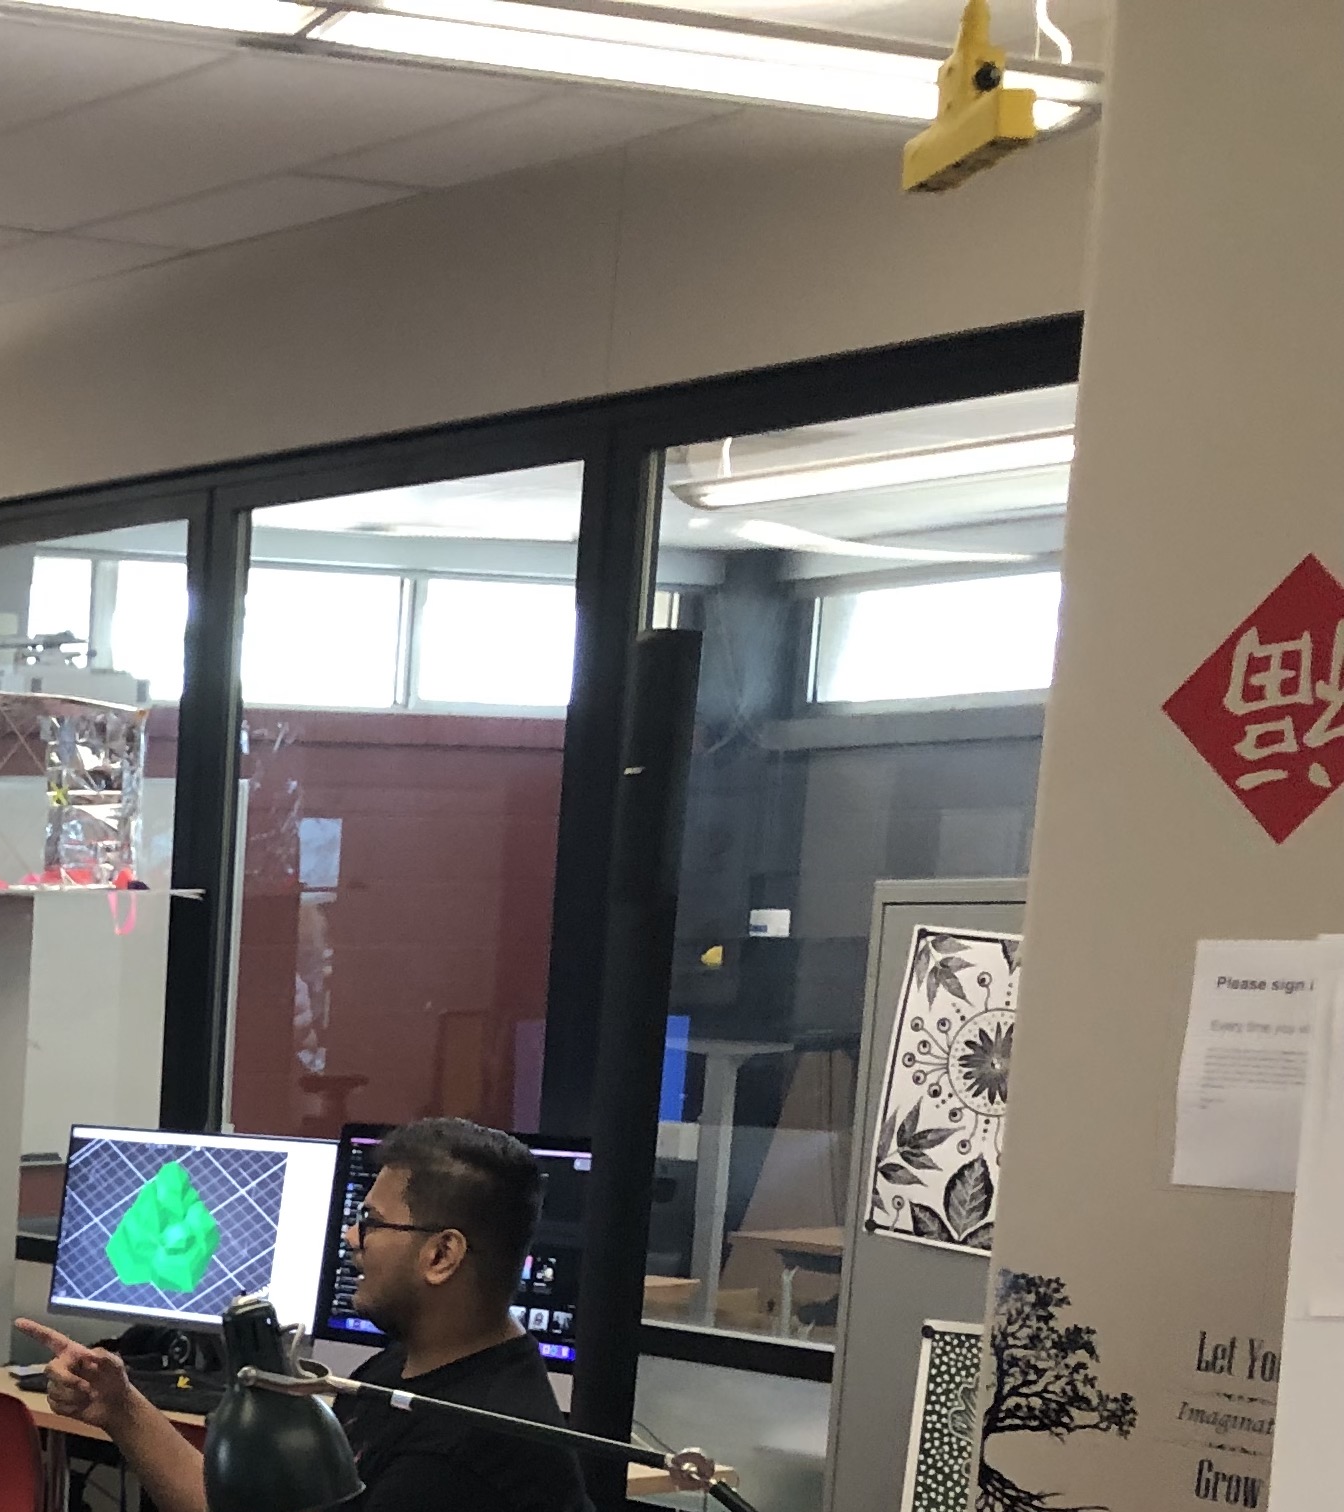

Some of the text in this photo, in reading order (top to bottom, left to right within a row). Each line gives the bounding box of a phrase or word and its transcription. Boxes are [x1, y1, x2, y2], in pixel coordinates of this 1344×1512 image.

[1216, 975, 1267, 990] Please
[1271, 978, 1305, 994] sign
[1195, 1330, 1237, 1377] Let
[1194, 1457, 1264, 1509] Grow
